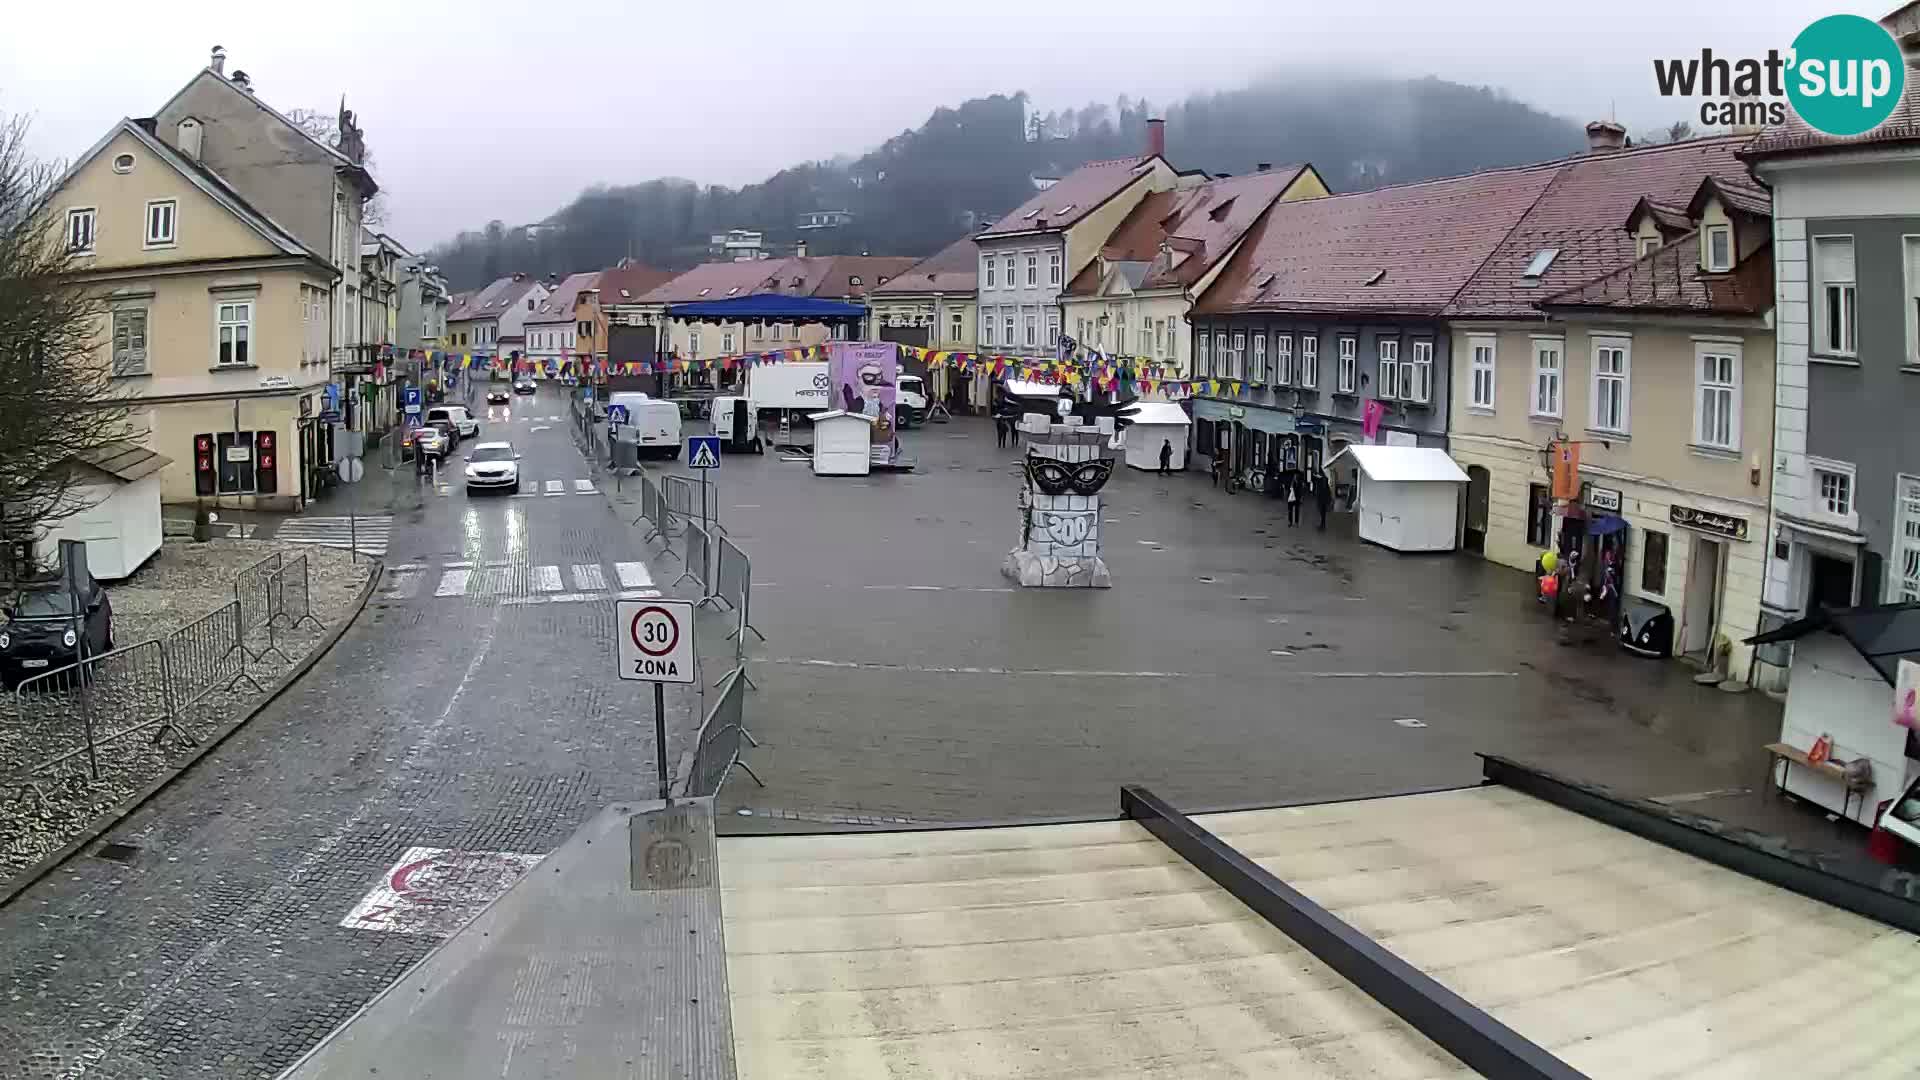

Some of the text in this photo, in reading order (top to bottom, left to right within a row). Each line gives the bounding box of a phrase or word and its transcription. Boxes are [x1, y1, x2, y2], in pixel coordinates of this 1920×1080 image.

[408, 391, 417, 403] P
[1048, 516, 1087, 546] 200
[643, 621, 668, 643] 30
[633, 659, 679, 676] ZONA
